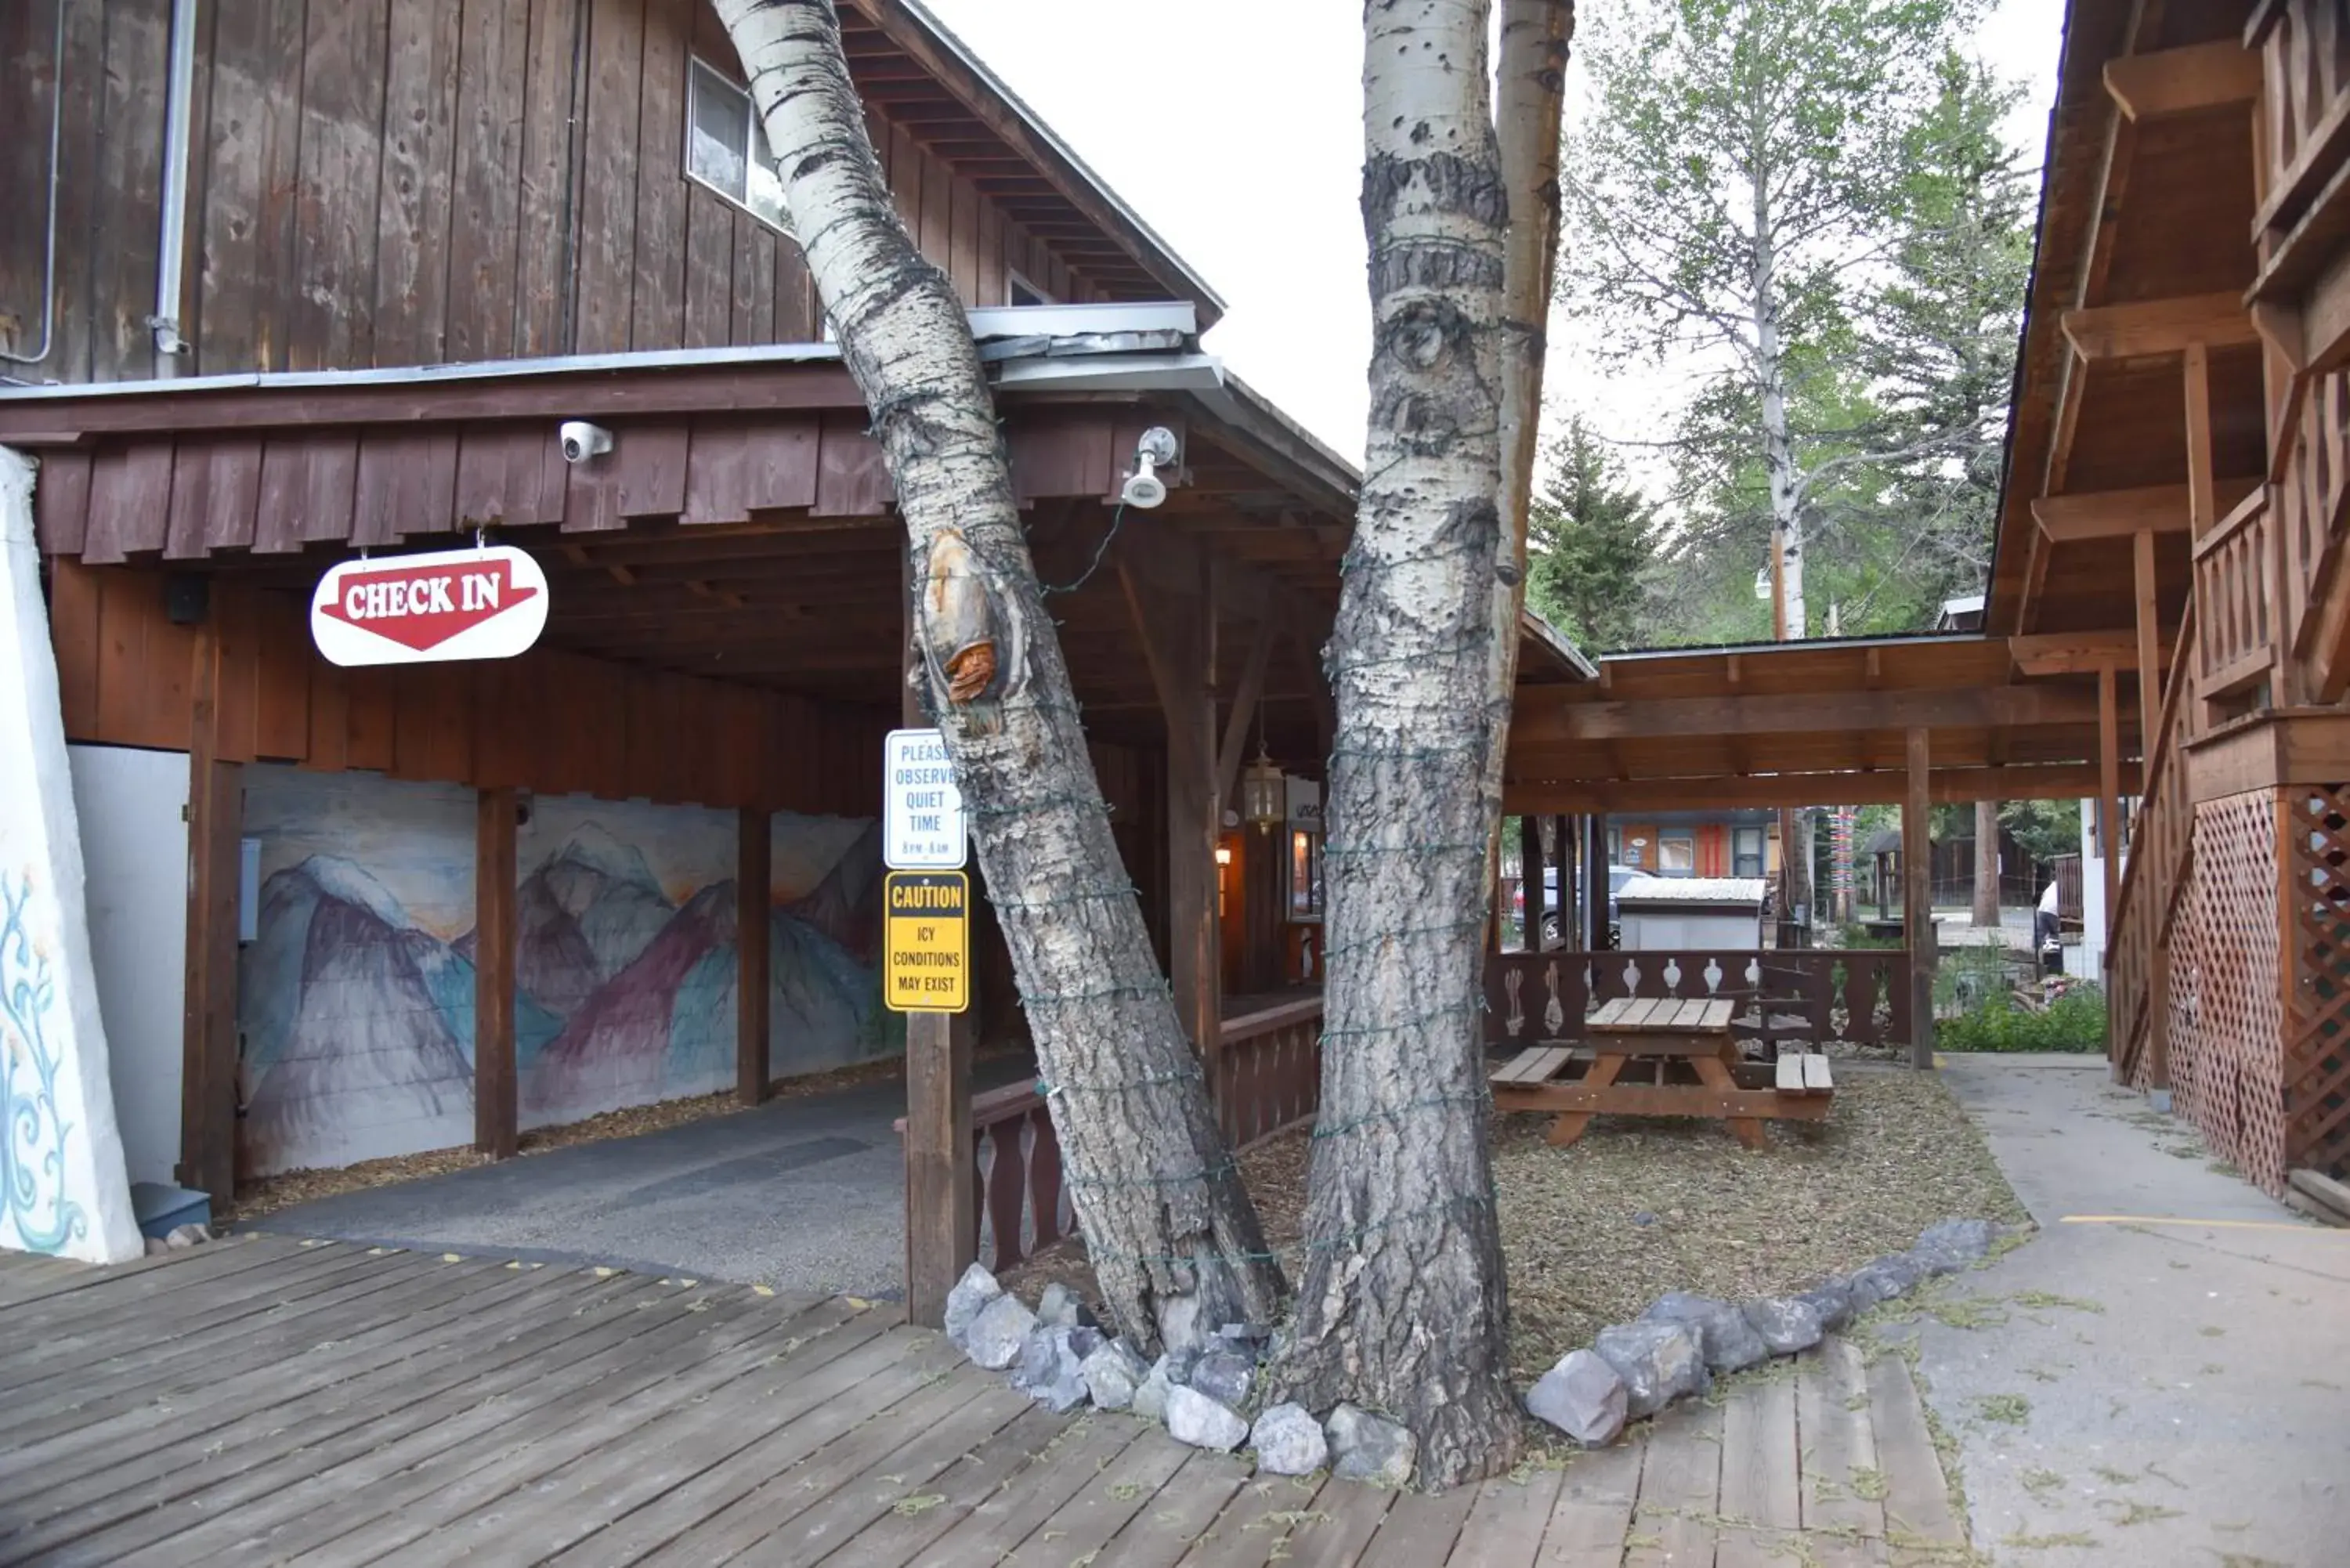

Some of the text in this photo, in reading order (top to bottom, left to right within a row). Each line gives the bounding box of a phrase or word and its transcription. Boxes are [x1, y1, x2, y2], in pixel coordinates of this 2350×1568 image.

[345, 573, 501, 620] CHECK IN
[906, 792, 945, 810] QUIET
[909, 815, 942, 832] TIME
[892, 886, 961, 909] CAUTION
[917, 927, 935, 941] ICY
[893, 952, 960, 967] CONDITIONS
[898, 977, 955, 992] MAY EXIST
